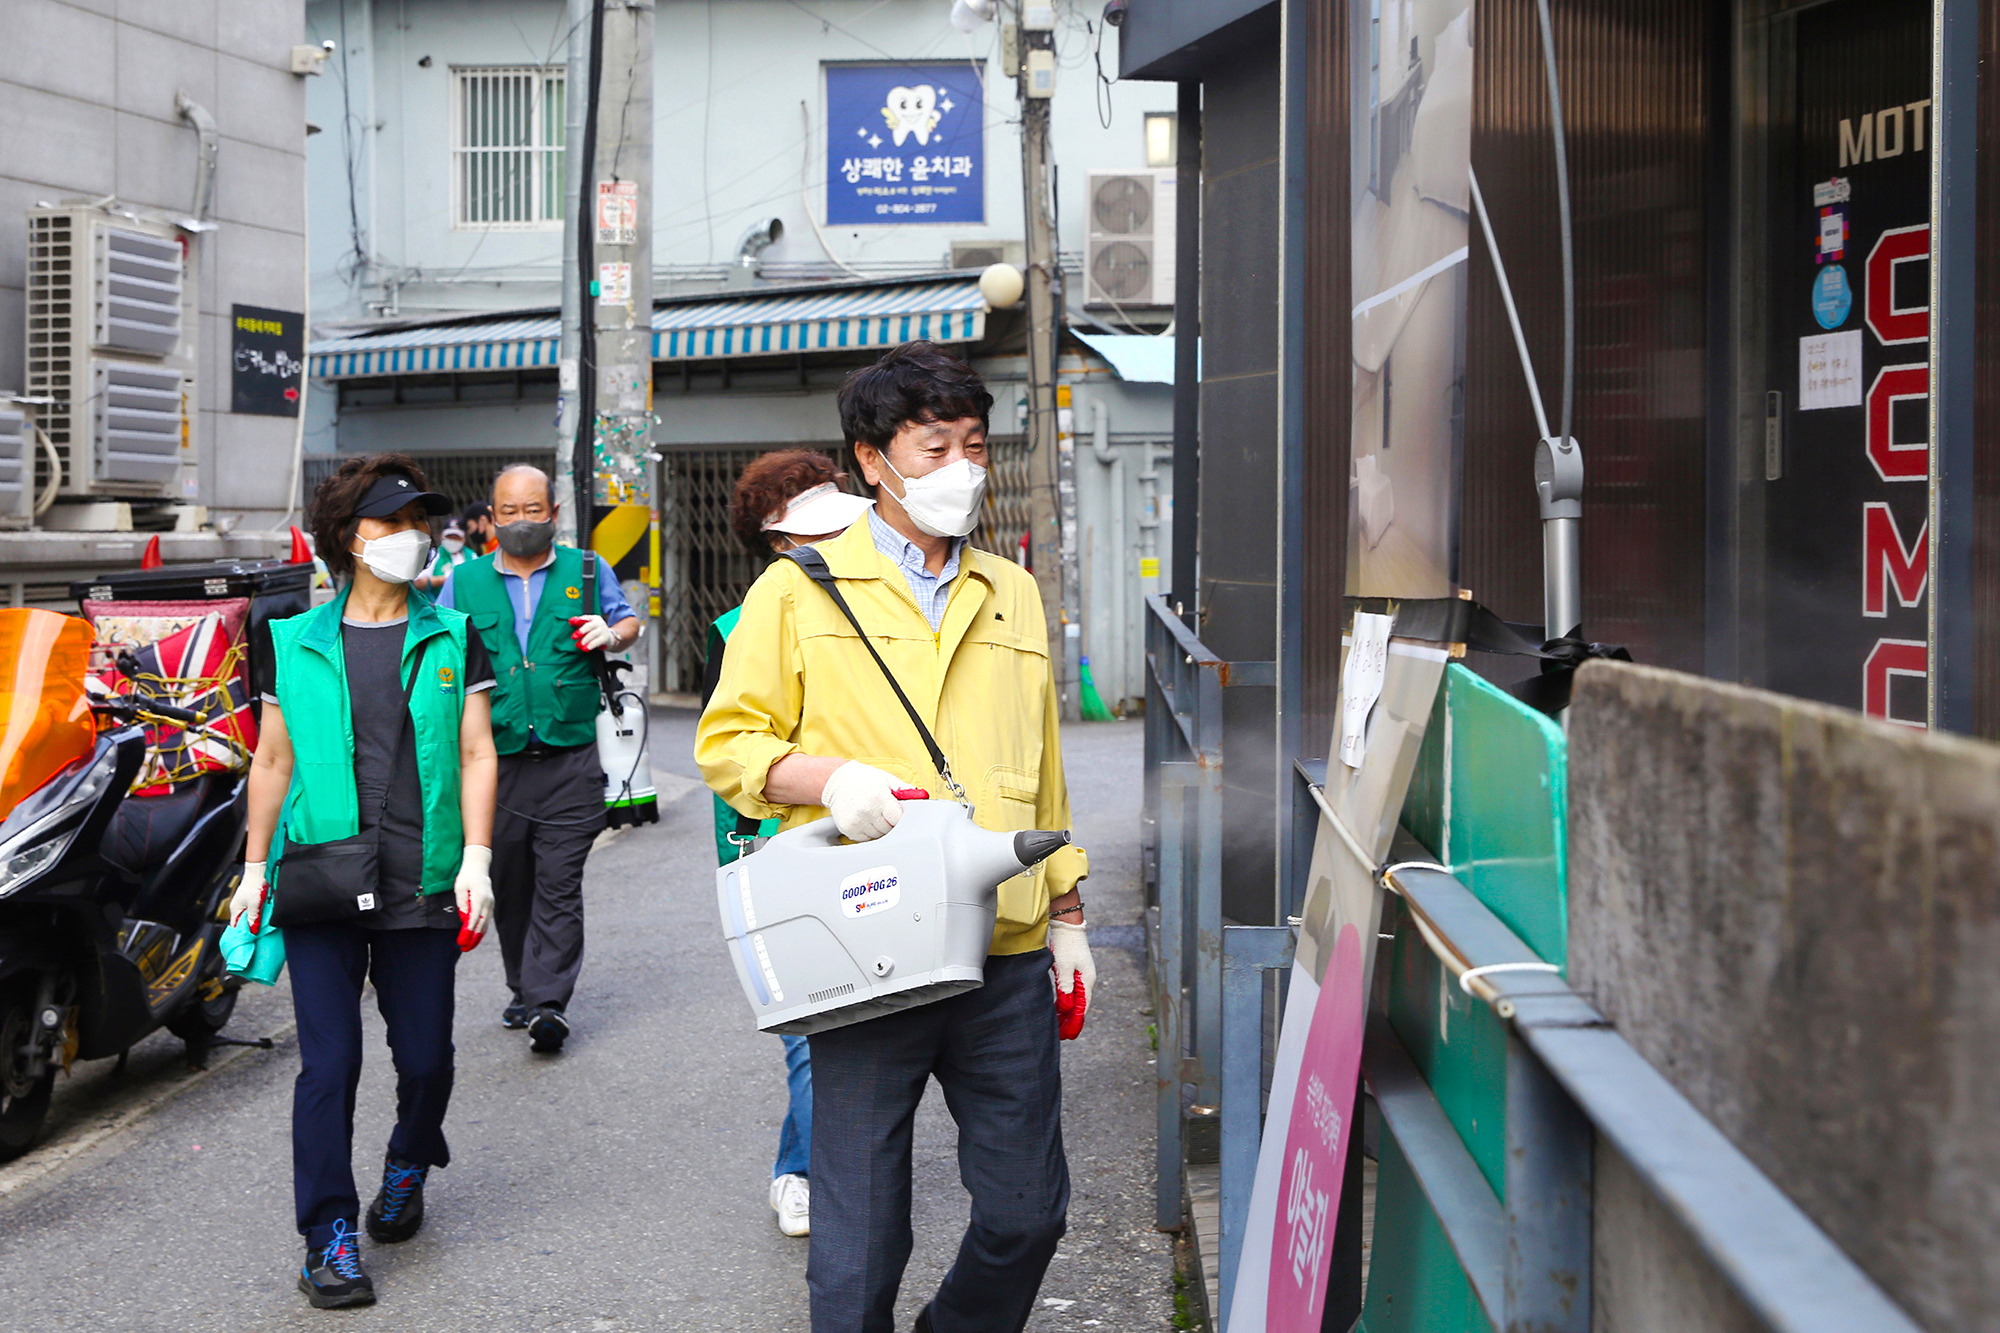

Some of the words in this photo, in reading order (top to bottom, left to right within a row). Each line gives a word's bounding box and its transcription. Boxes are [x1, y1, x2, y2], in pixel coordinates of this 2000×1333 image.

[840, 157, 904, 183] 상쾌한
[909, 156, 973, 181] 윤치과
[842, 885, 867, 900] GOOD
[886, 876, 898, 889] 26
[1288, 1147, 1329, 1314] 야놀자
